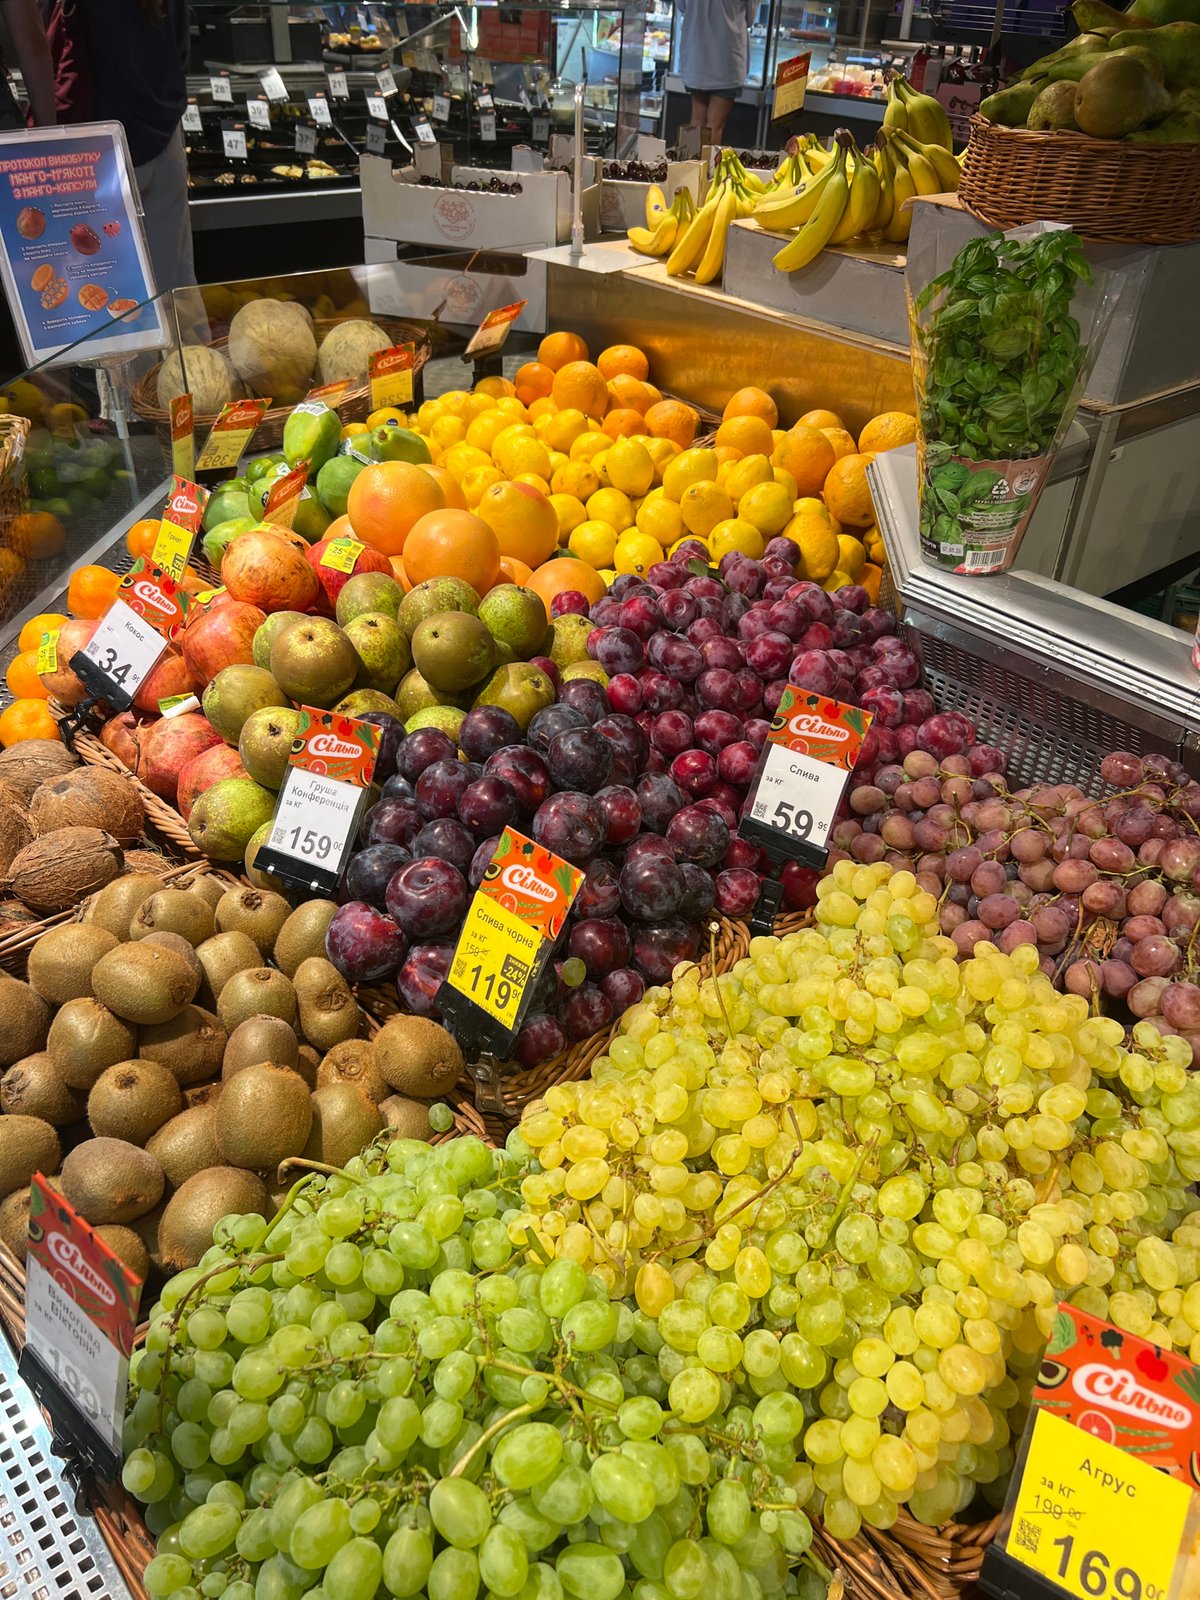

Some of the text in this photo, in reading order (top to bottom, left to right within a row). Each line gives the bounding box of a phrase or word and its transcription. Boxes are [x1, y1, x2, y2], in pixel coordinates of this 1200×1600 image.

[227, 139, 239, 149] 47
[0, 151, 100, 172] ПРОТОКОЛ ВИДОБУТКУ
[14, 180, 97, 199] З МАНГО-КАПСУЛИ
[139, 583, 175, 612] Сільпо
[124, 621, 146, 642] Кокос
[98, 647, 133, 686] 34
[795, 716, 847, 739] Сільпо
[313, 735, 360, 756] Сільпо
[765, 775, 773, 783] за
[789, 763, 820, 783] Слива
[290, 785, 350, 813] Конференція
[309, 779, 338, 797] Груша
[285, 799, 293, 807] за
[771, 800, 814, 840] 59
[289, 826, 332, 860] 159
[508, 867, 556, 900] Сільпо
[470, 931, 478, 940] за
[476, 907, 534, 949] Слива чорна
[470, 964, 512, 1010] 119
[502, 965, 527, 988] -24%
[53, 1238, 114, 1301] Сільпо
[33, 1300, 42, 1313] за
[47, 1283, 102, 1349] Виноград
[49, 1302, 97, 1360] Вікторія
[48, 1348, 101, 1421] 199
[1084, 1370, 1187, 1424] Сільпо
[1040, 1476, 1053, 1490] за
[1079, 1457, 1137, 1499] Агрус
[1033, 1493, 1082, 1521] 199 00
[1052, 1534, 1143, 1600] 169
